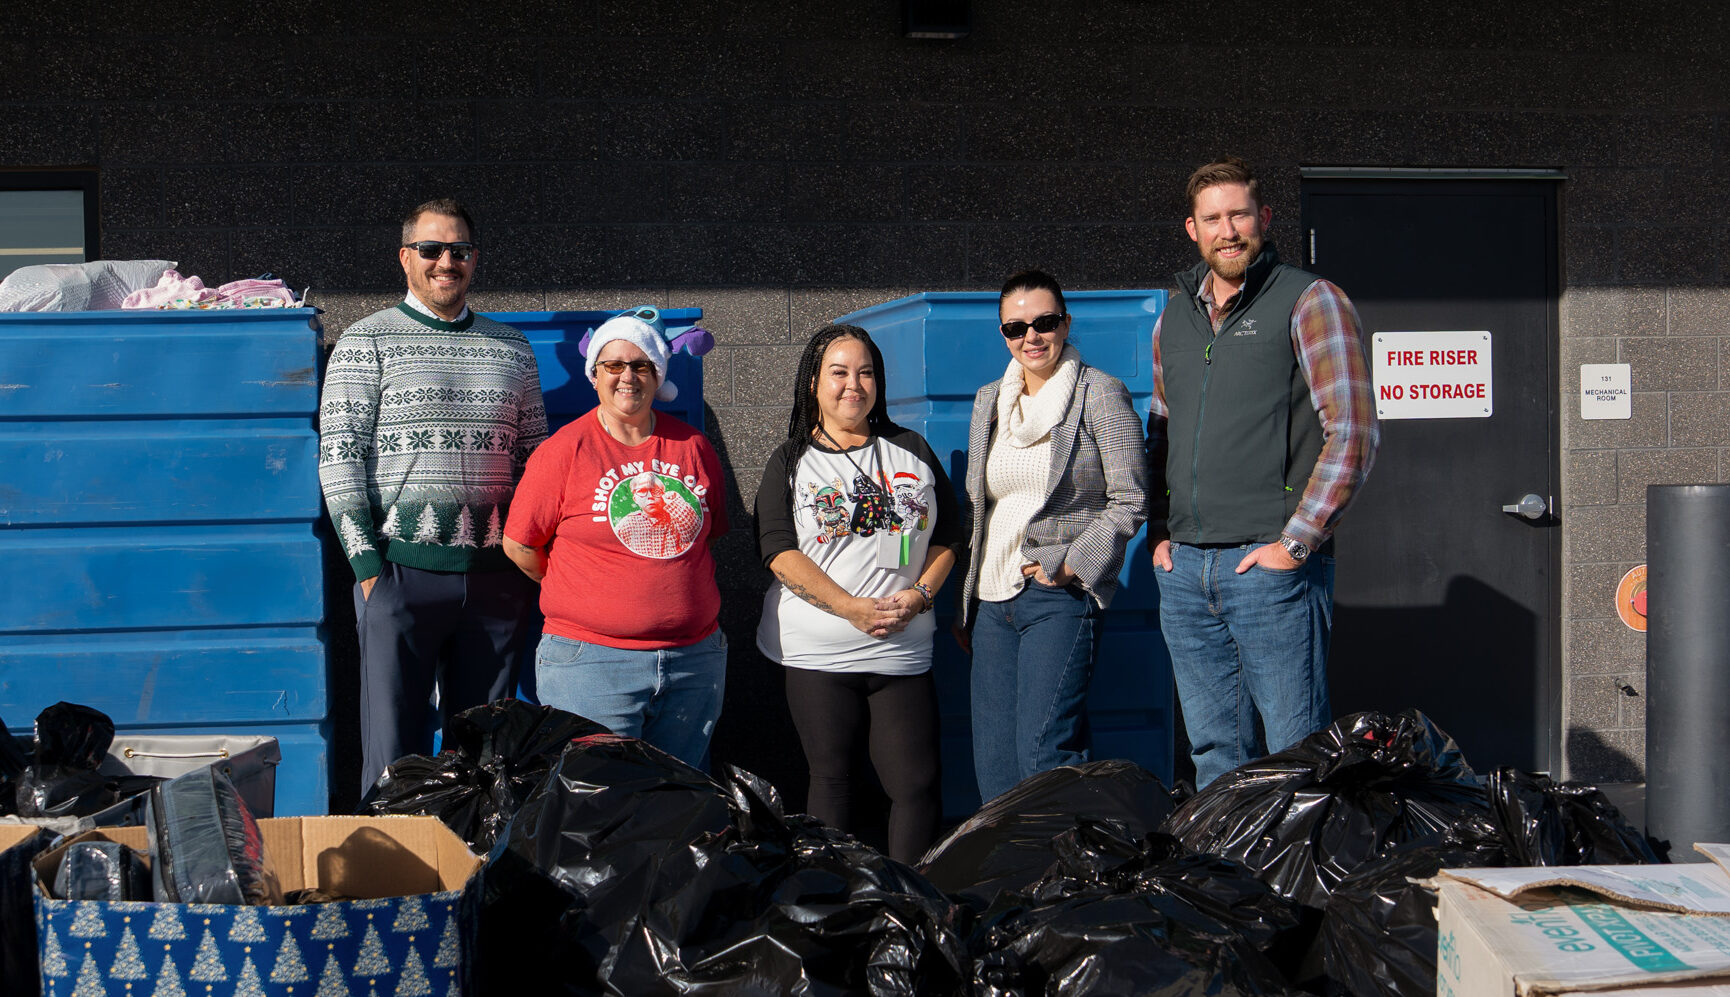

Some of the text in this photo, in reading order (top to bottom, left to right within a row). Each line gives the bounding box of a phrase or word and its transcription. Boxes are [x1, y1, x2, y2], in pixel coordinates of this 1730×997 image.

[1387, 350, 1478, 366] FIRE RISER
[1380, 384, 1486, 400] NO STORAGE
[592, 468, 620, 512] SHOT
[620, 461, 645, 477] MY
[651, 458, 681, 478] EYE
[1603, 928, 1664, 957] PIVOT
